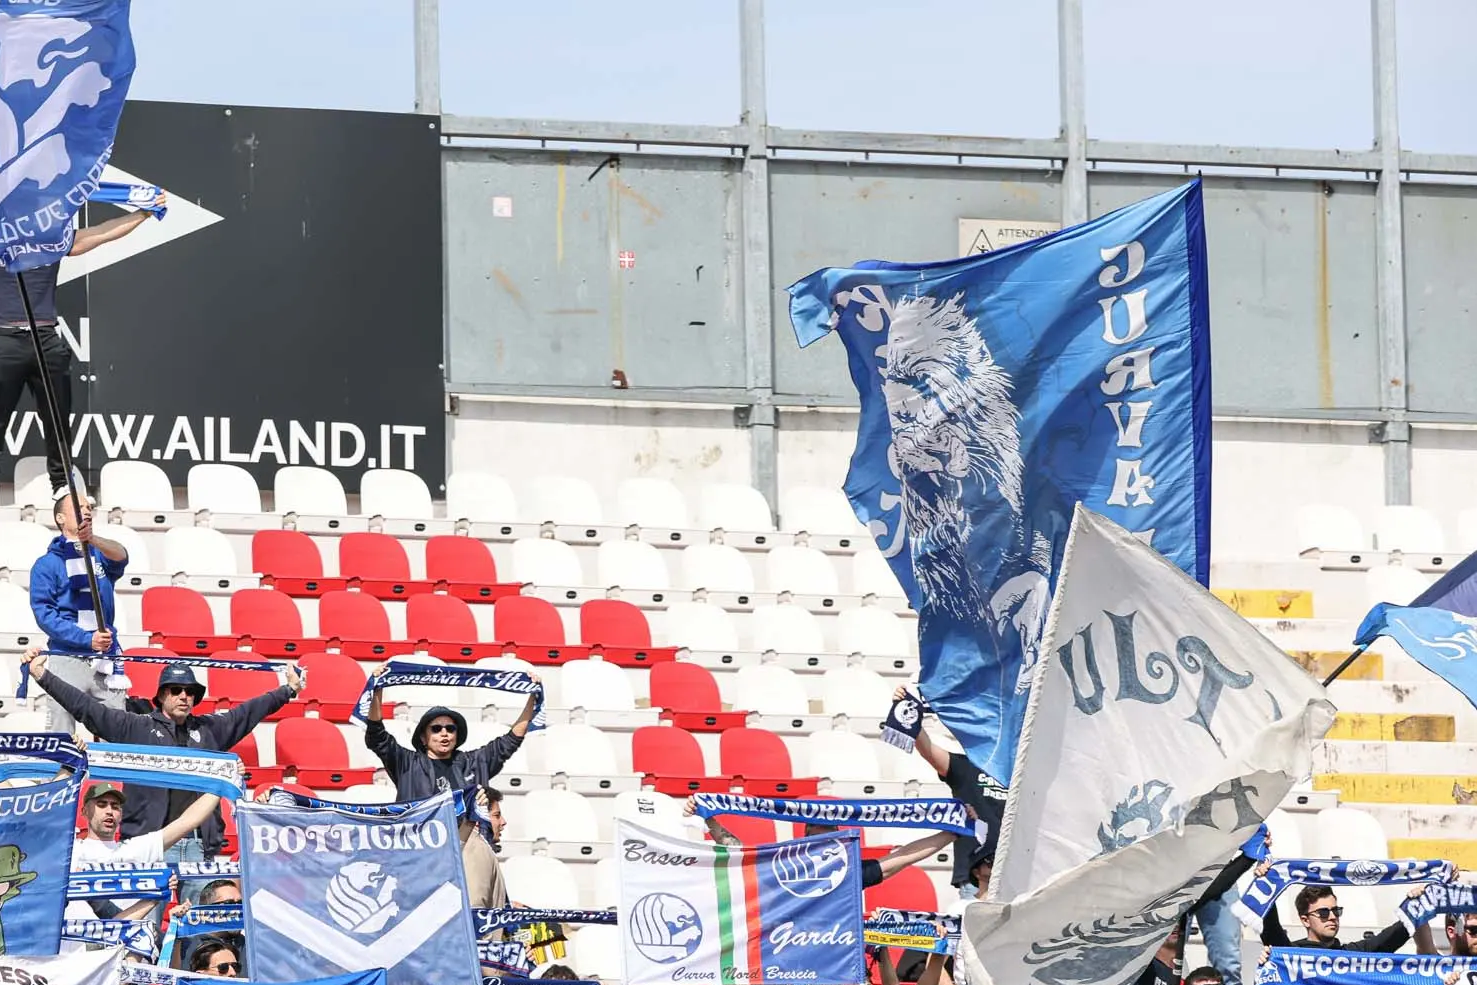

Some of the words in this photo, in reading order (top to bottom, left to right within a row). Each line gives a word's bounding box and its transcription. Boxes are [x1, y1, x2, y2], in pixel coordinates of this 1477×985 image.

[697, 792, 777, 815] CURVA
[783, 802, 854, 822] NORD
[860, 802, 969, 827] BRESCIA
[250, 820, 447, 854] BOTTICINO
[623, 838, 699, 868] Basso
[769, 921, 856, 954] Garda
[671, 966, 716, 982] Curva
[721, 965, 760, 981] Nord
[766, 965, 818, 981] Brescia
[1282, 953, 1394, 982] VECCHIO
